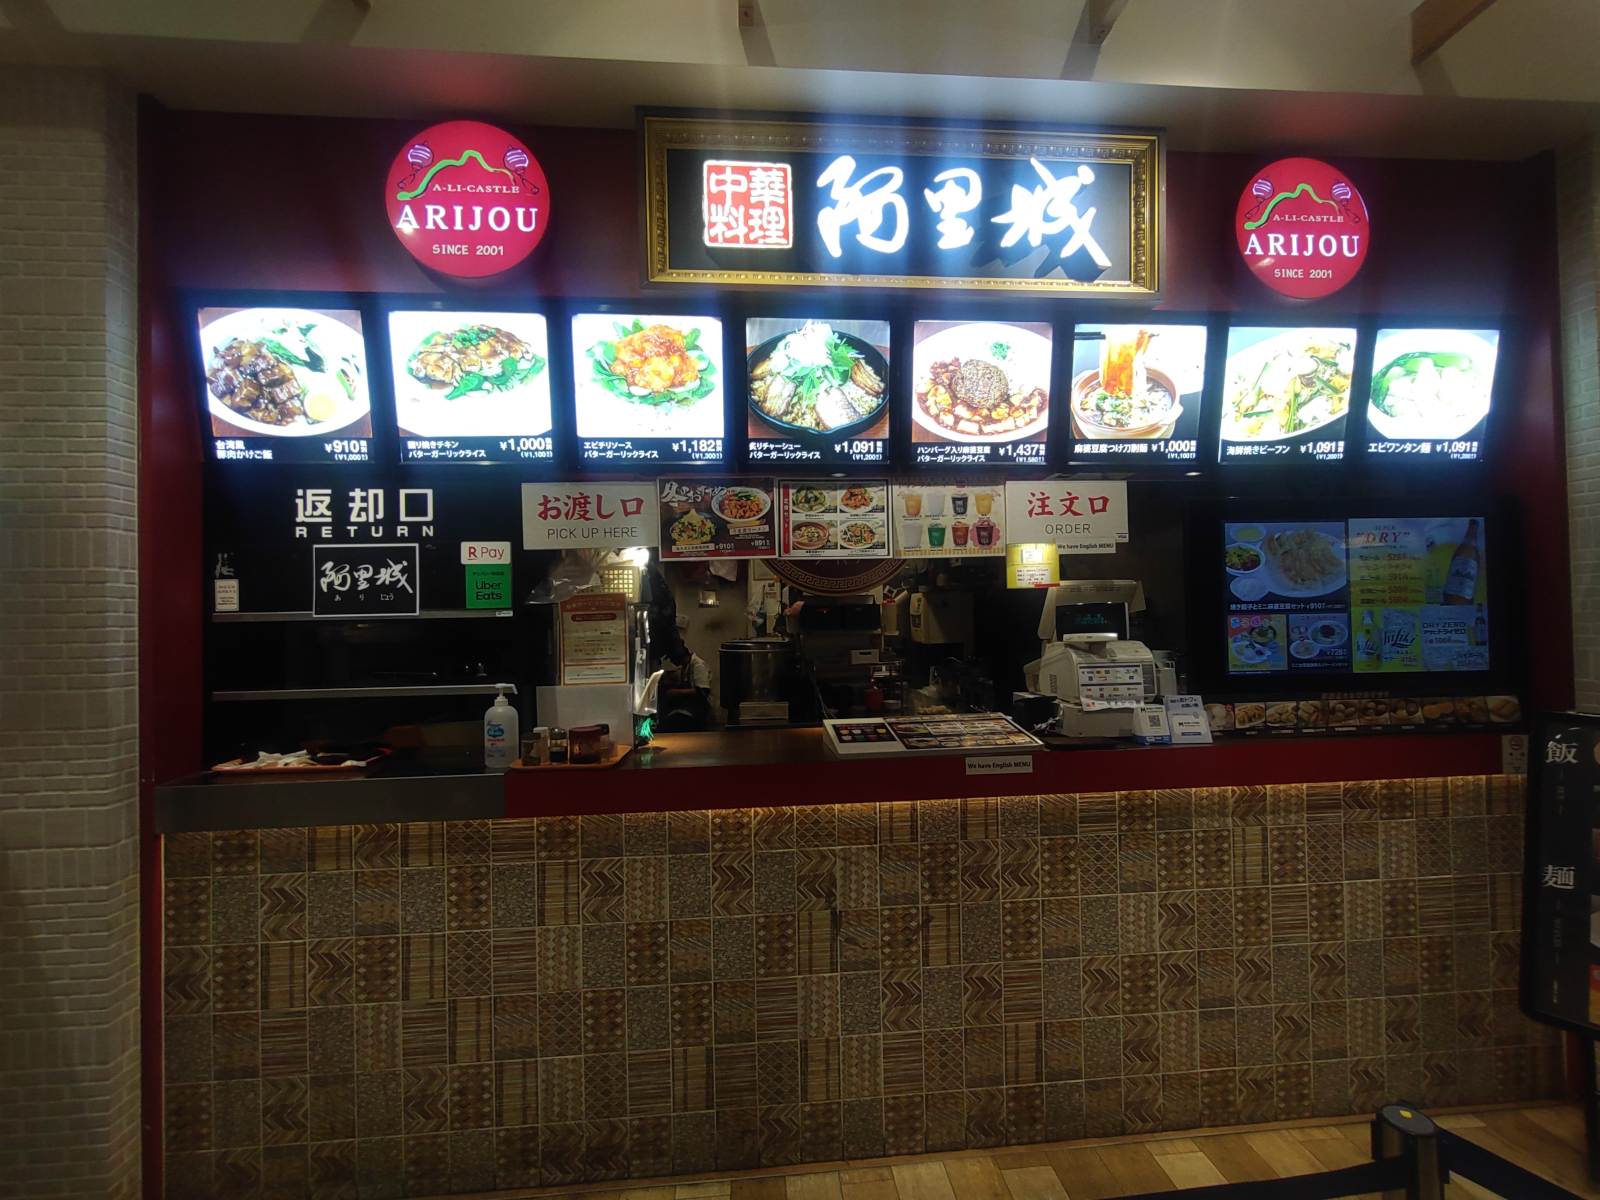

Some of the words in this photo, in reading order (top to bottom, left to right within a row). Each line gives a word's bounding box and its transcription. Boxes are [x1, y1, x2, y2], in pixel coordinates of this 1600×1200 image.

[432, 183, 520, 193] A-LI-CASTLE
[396, 204, 538, 232] ARIJOU
[816, 155, 1111, 270] 阿里城
[1273, 214, 1344, 223] A-LI-CASTLE
[432, 244, 469, 255] SINCE
[476, 245, 503, 256] 2001
[1244, 233, 1359, 257] ARIJOU
[1274, 268, 1304, 278] SINCE
[1309, 269, 1333, 279] 2001
[325, 440, 359, 453] ¥910
[500, 438, 545, 452] ¥1,000
[583, 441, 633, 450] エビチリソース
[672, 440, 715, 453] ¥1,182
[834, 441, 874, 454] ¥1,091
[999, 444, 1039, 457] ¥1,437
[1151, 441, 1190, 453] ¥1,000
[1226, 445, 1290, 455] 海鮮焼きビーフン
[1300, 442, 1336, 455] ¥1,091
[1436, 441, 1471, 454] ¥1,091
[295, 488, 433, 523] 返却口
[537, 491, 645, 521] お渡し口
[1027, 491, 1110, 518] 注文口
[295, 526, 434, 538] RETURN
[547, 528, 577, 539] PICK
[581, 527, 599, 539] UP
[603, 526, 638, 538] HERE
[1045, 523, 1091, 535] ORDER
[1079, 542, 1097, 550] English
[480, 546, 505, 560] Pay
[320, 558, 414, 594] 阿里城
[475, 580, 502, 590] Uber
[475, 591, 503, 601] Eats
[1545, 741, 1578, 764] 飯
[992, 761, 1013, 770] English
[1542, 864, 1576, 890] 麺
